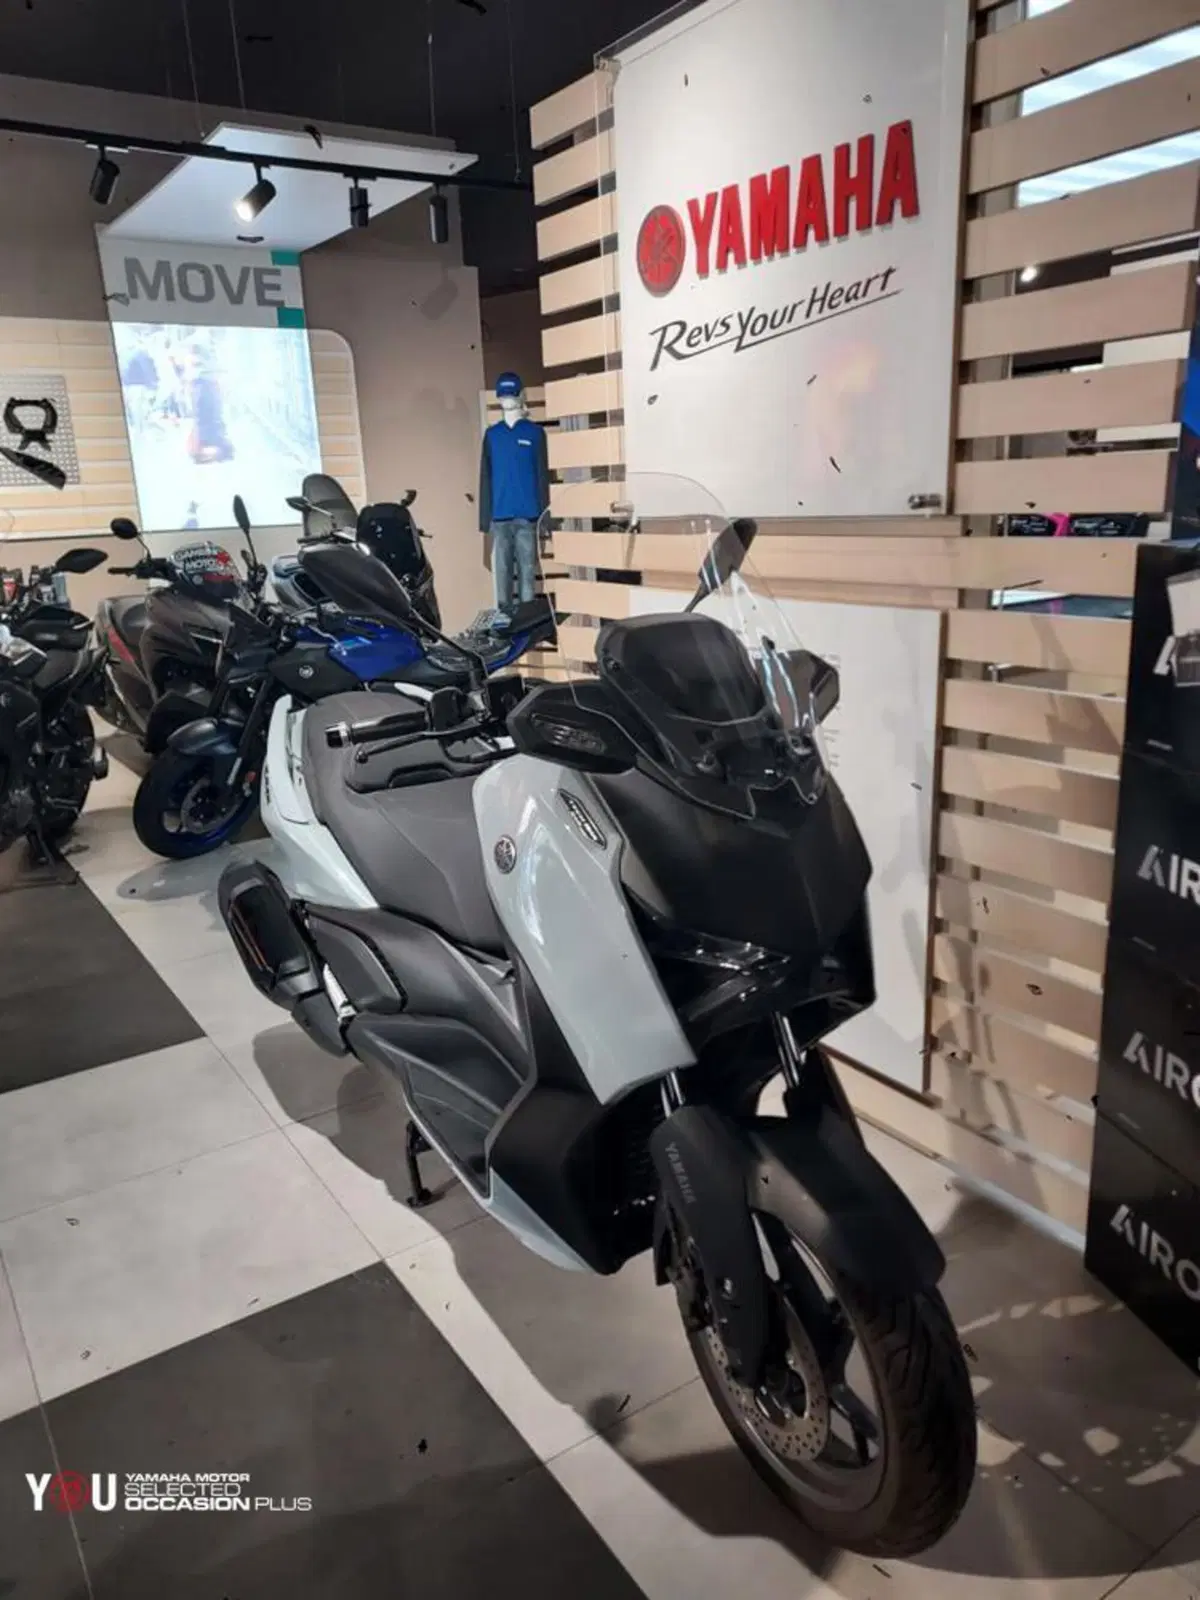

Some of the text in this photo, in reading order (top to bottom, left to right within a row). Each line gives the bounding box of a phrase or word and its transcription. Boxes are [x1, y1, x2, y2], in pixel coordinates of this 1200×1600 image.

[687, 119, 920, 279] YAMAHA
[124, 256, 285, 307] MOVE
[649, 265, 898, 371] Revs Your Heart
